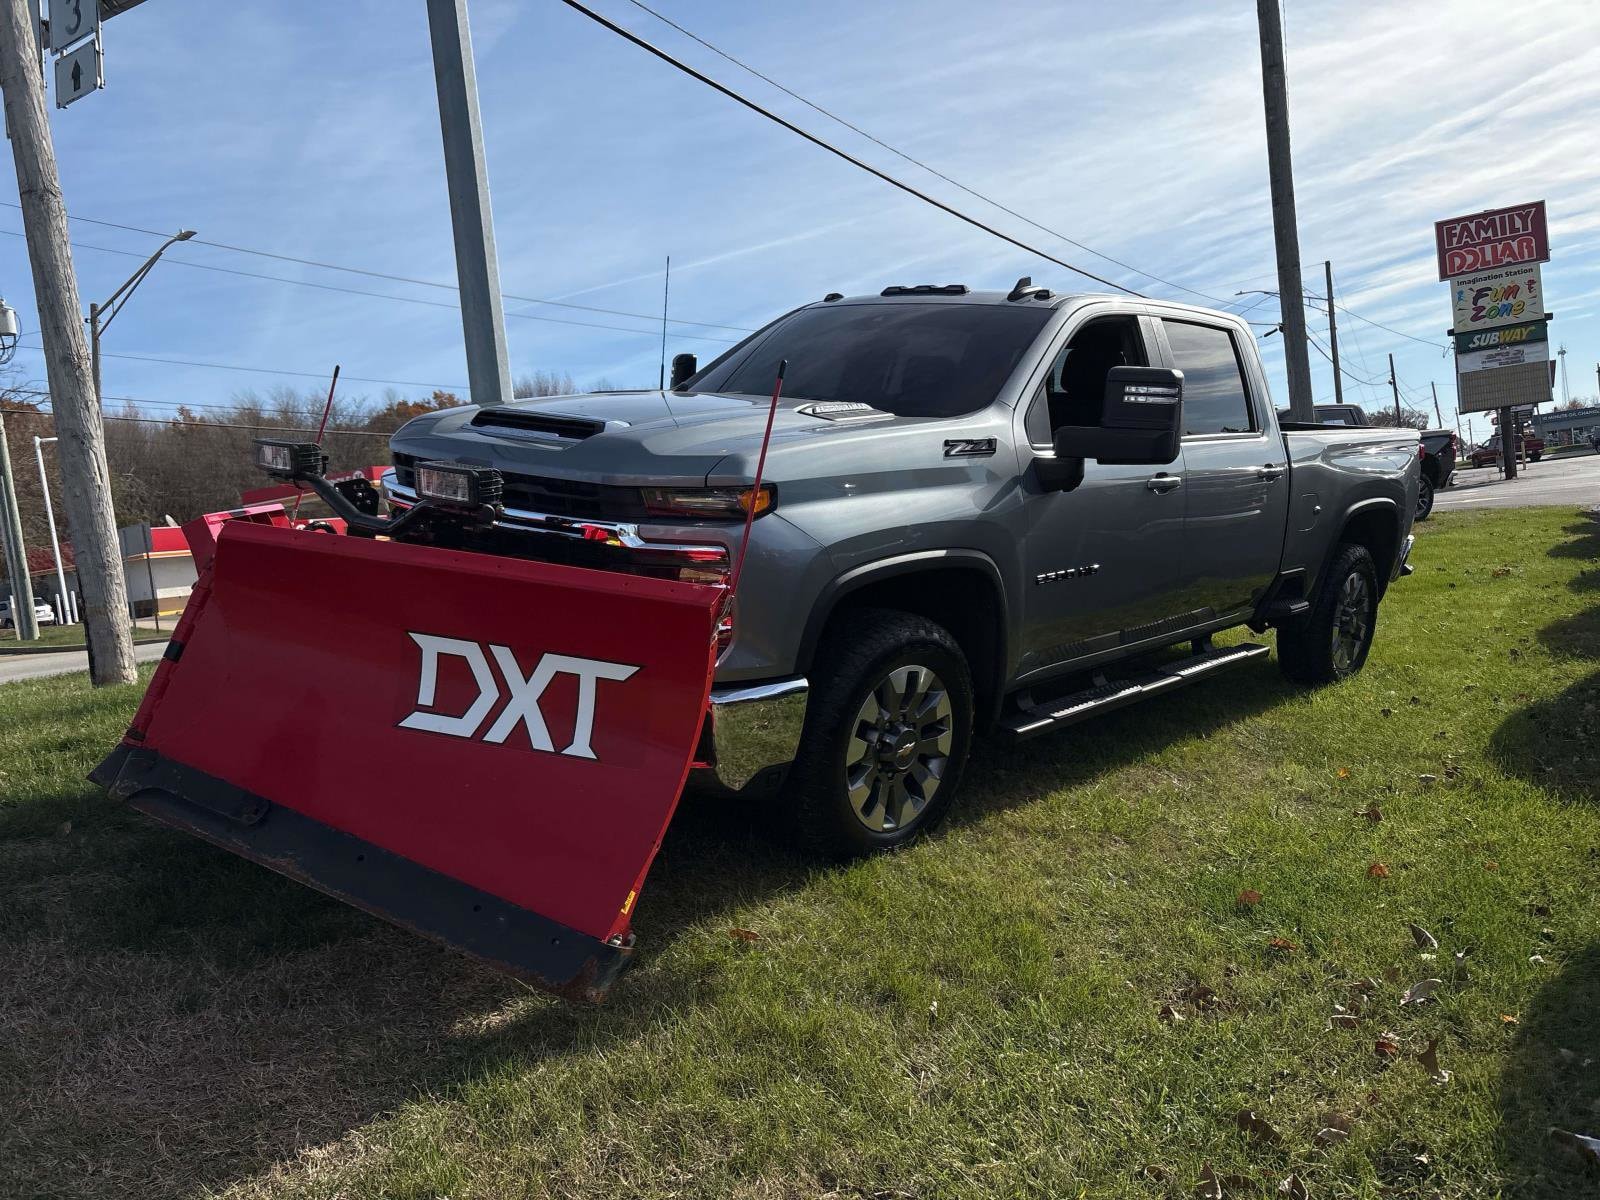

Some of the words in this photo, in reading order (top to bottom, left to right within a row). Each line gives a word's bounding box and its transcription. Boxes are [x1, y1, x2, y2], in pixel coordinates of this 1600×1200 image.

[65, 0, 82, 35] 3
[1443, 207, 1537, 249] FAMILY
[1445, 235, 1537, 275] DOLLAR
[1456, 273, 1503, 286] Imagination
[1504, 267, 1534, 278] Station
[1471, 284, 1521, 306] Fun
[1468, 326, 1536, 349] SUBWAY
[944, 438, 997, 457] Z71
[396, 630, 643, 762] DXT
